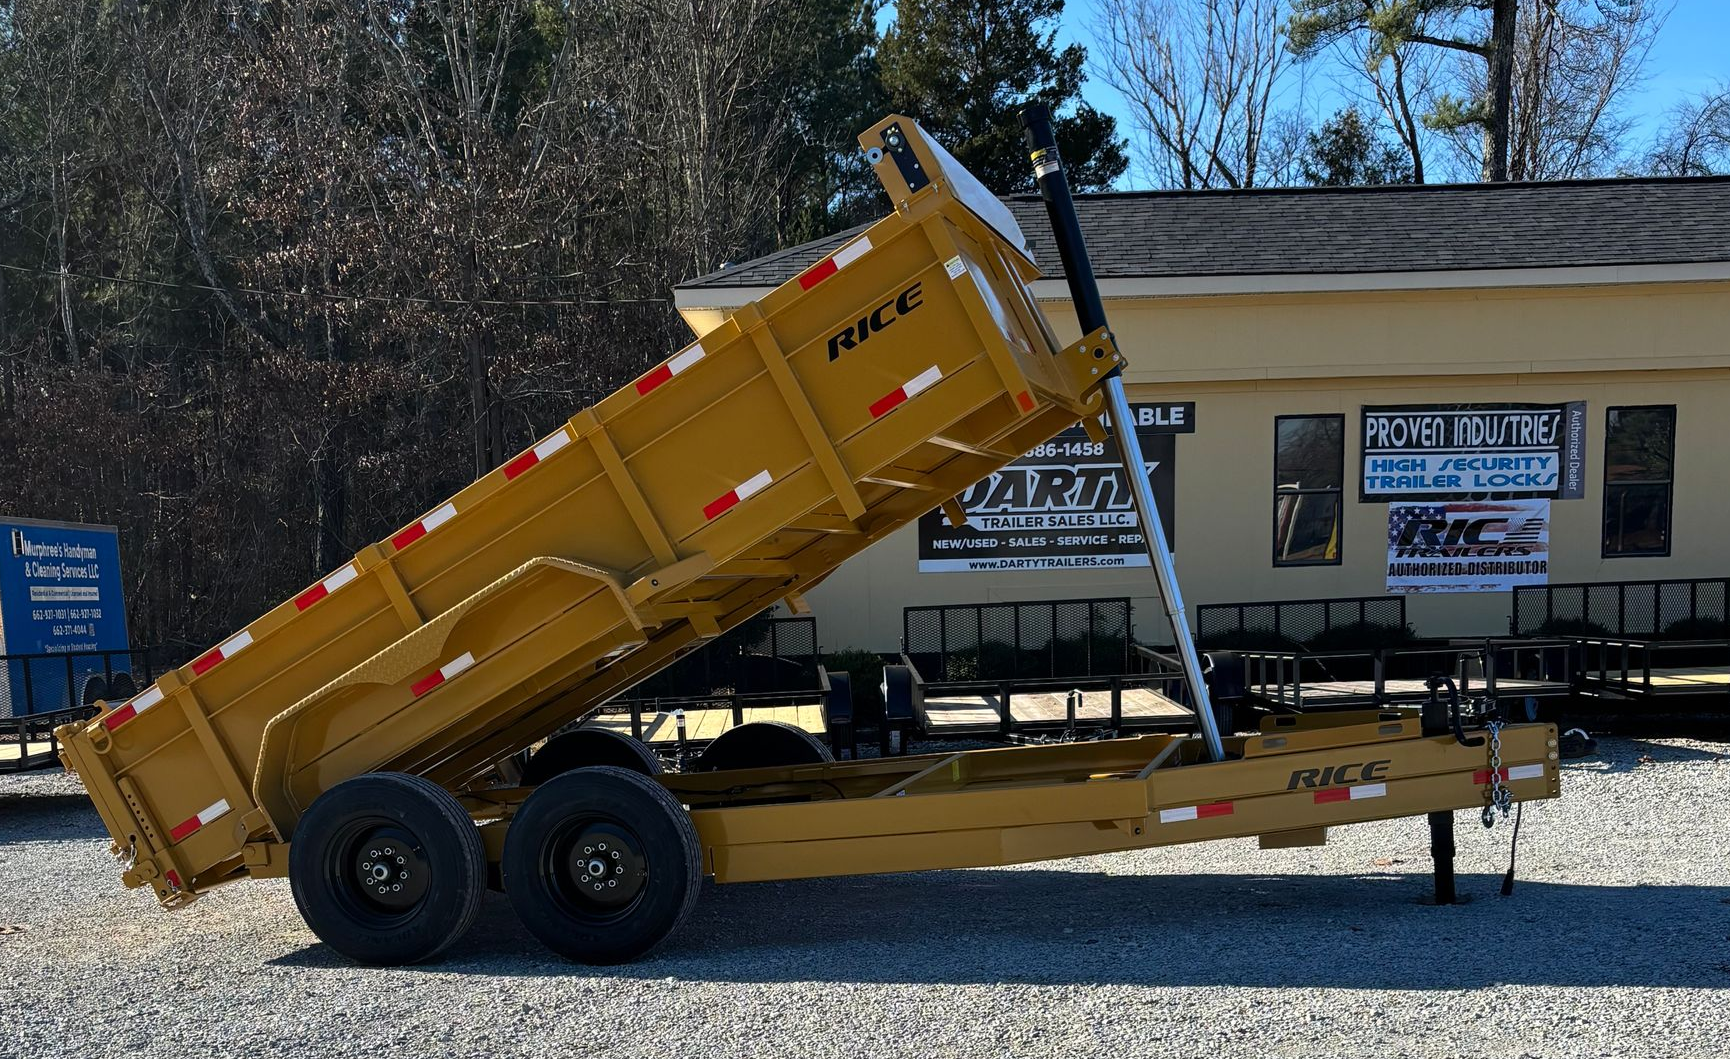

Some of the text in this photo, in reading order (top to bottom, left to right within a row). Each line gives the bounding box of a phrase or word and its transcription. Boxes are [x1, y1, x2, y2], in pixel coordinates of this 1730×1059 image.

[827, 281, 924, 363] RICE
[1366, 414, 1561, 448] PROVEN INDUSTRIES
[1569, 410, 1582, 491] Authorized Dealer
[1371, 456, 1552, 473] HIGH SECURITY
[1365, 472, 1557, 489] TRAILER LOCKS
[981, 514, 1130, 529] TRAILER SALES LLC.
[24, 540, 97, 562] Murphree's Handyman
[933, 538, 998, 550] NEW/USED
[1008, 537, 1046, 548] SALES
[1057, 535, 1108, 546] SERVICE
[25, 561, 99, 581] & Cleaning Services LLC
[969, 557, 1125, 570] www.DARTYTRAILERS.com
[1388, 560, 1548, 577] AUTHORIZED DISTRIBUTOR
[1286, 759, 1392, 790] RICE
